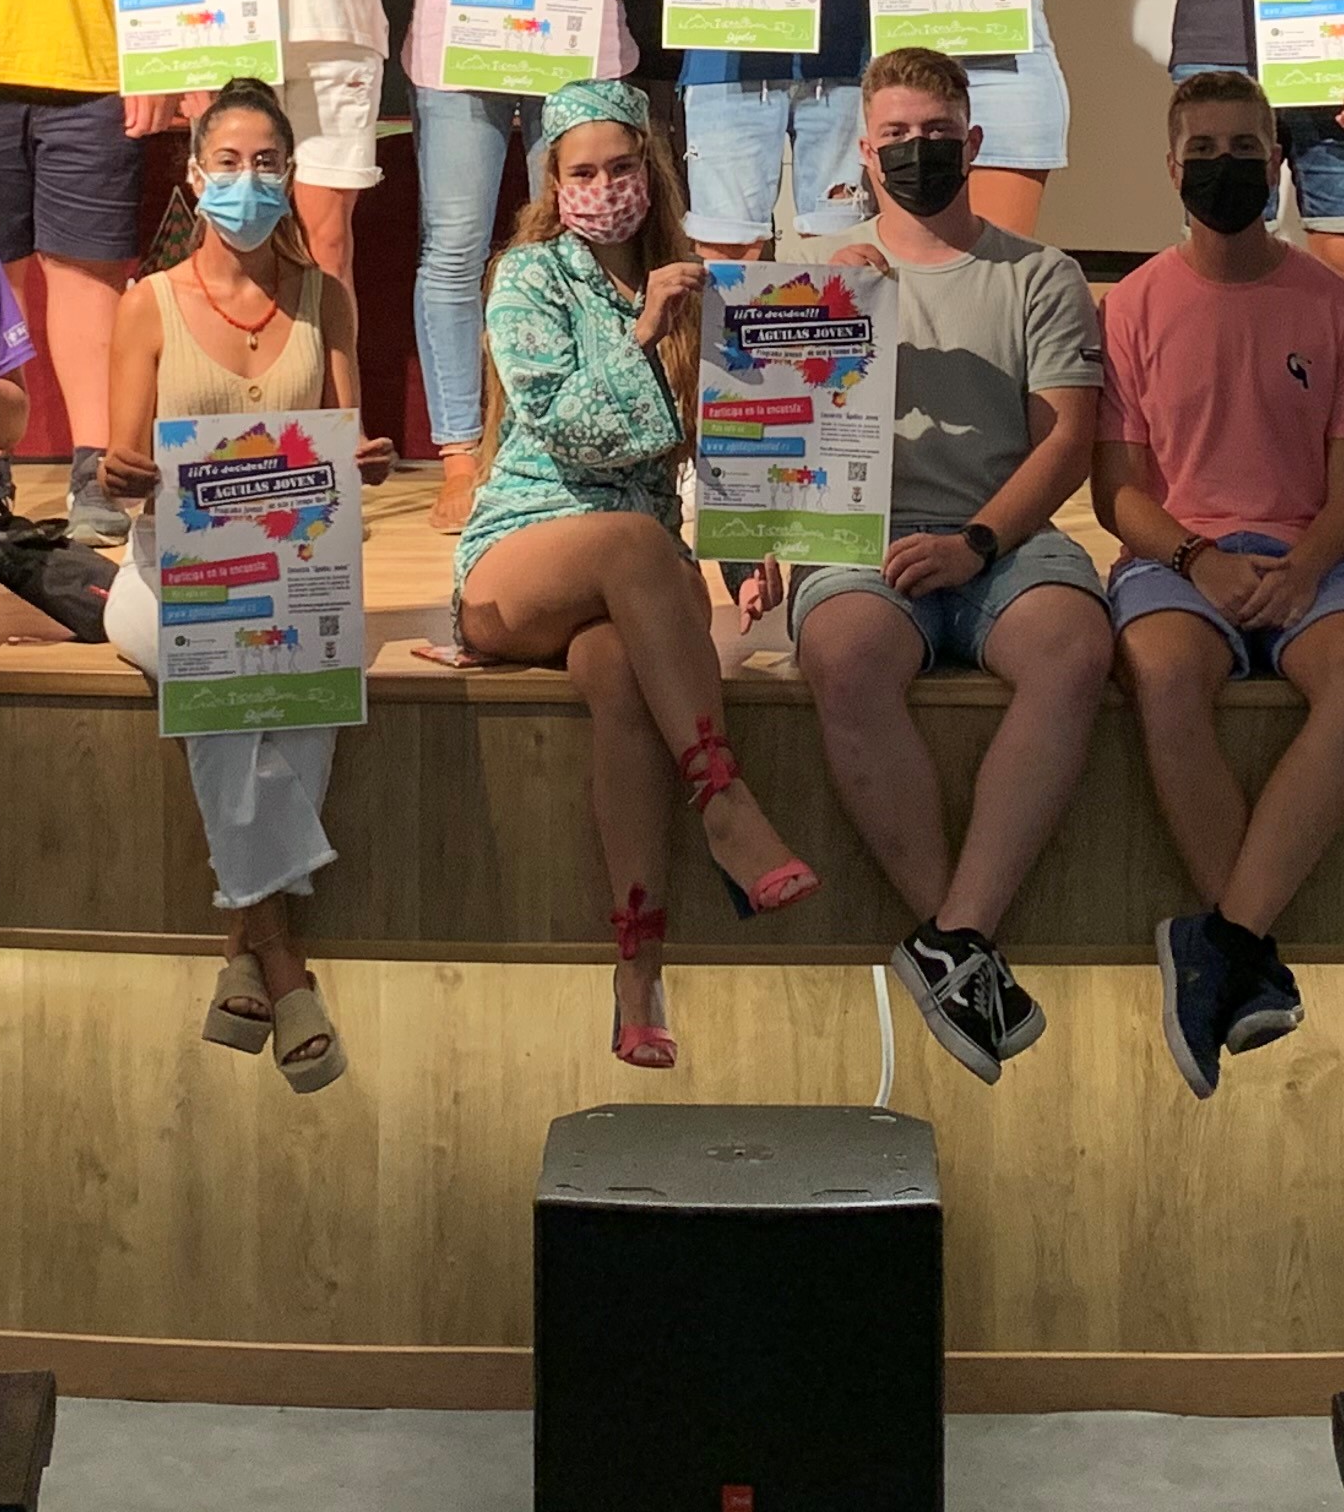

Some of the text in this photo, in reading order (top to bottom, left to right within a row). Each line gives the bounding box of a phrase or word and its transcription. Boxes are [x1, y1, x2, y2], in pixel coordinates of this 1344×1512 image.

[757, 326, 854, 341] ÁGUILAS JOVEN
[213, 473, 316, 499] ÁGUILAS JOVEN
